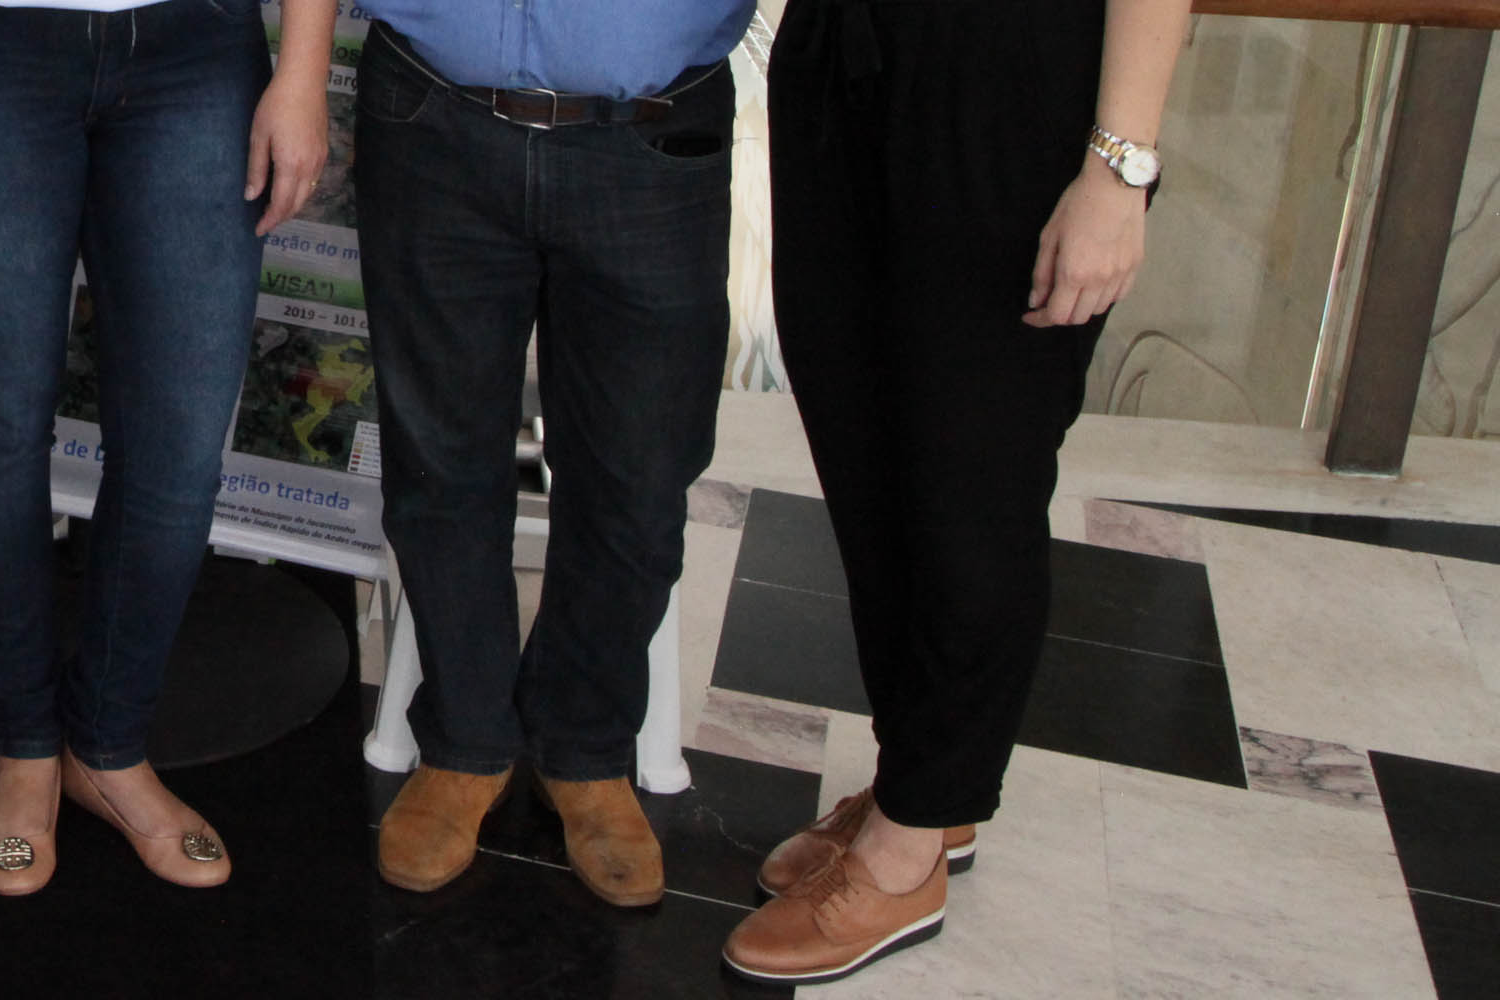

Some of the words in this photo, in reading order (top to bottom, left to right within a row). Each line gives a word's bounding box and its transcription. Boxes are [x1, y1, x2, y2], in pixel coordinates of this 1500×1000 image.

[315, 241, 337, 256] do
[283, 305, 315, 320] 2019
[333, 314, 356, 326] 101
[64, 439, 88, 459] de
[220, 473, 270, 495] egião
[277, 481, 349, 510] tratada
